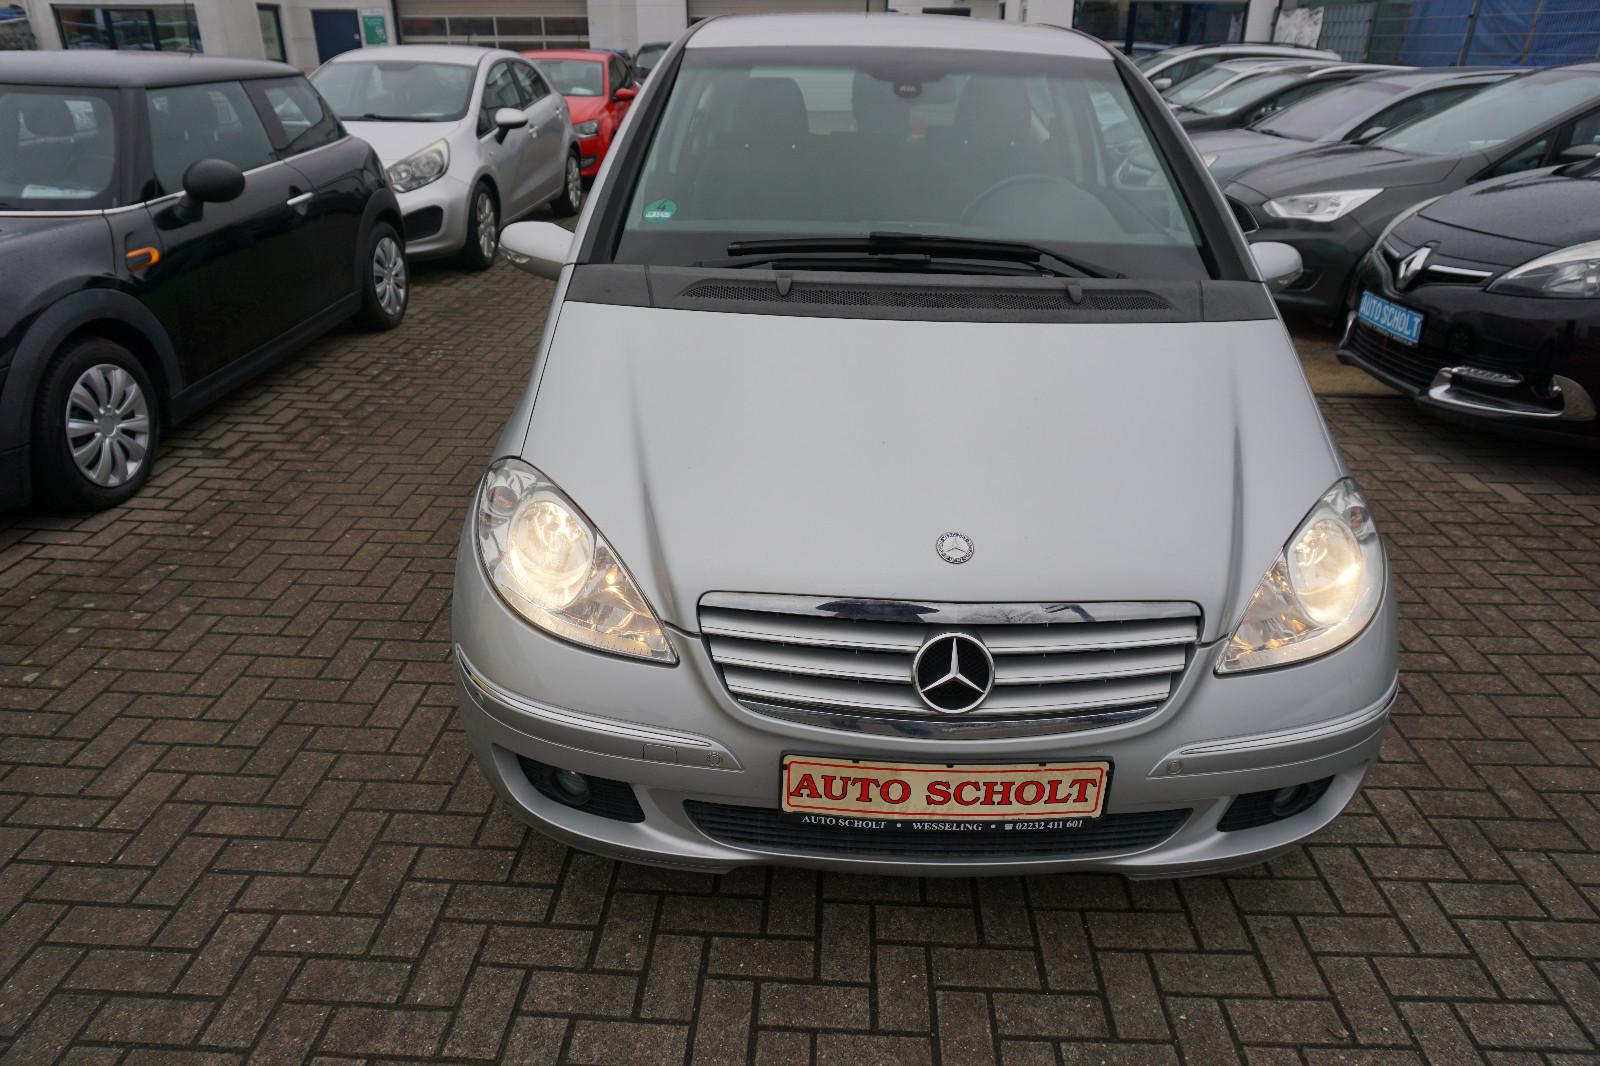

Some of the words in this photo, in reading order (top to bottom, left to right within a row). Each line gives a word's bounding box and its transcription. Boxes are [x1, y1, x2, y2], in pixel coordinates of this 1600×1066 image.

[655, 199, 667, 212] 4
[1360, 295, 1382, 321] AUTO
[1380, 304, 1421, 338] SCHOLT
[789, 773, 912, 805] AUTO
[925, 778, 1098, 806] SCHOLT
[802, 815, 836, 825] AUTO
[838, 818, 887, 829] SCHOLT
[912, 822, 983, 831] WESSELING
[1015, 821, 1045, 831] 02232
[1046, 820, 1063, 829] 411
[1066, 819, 1083, 828] 601
